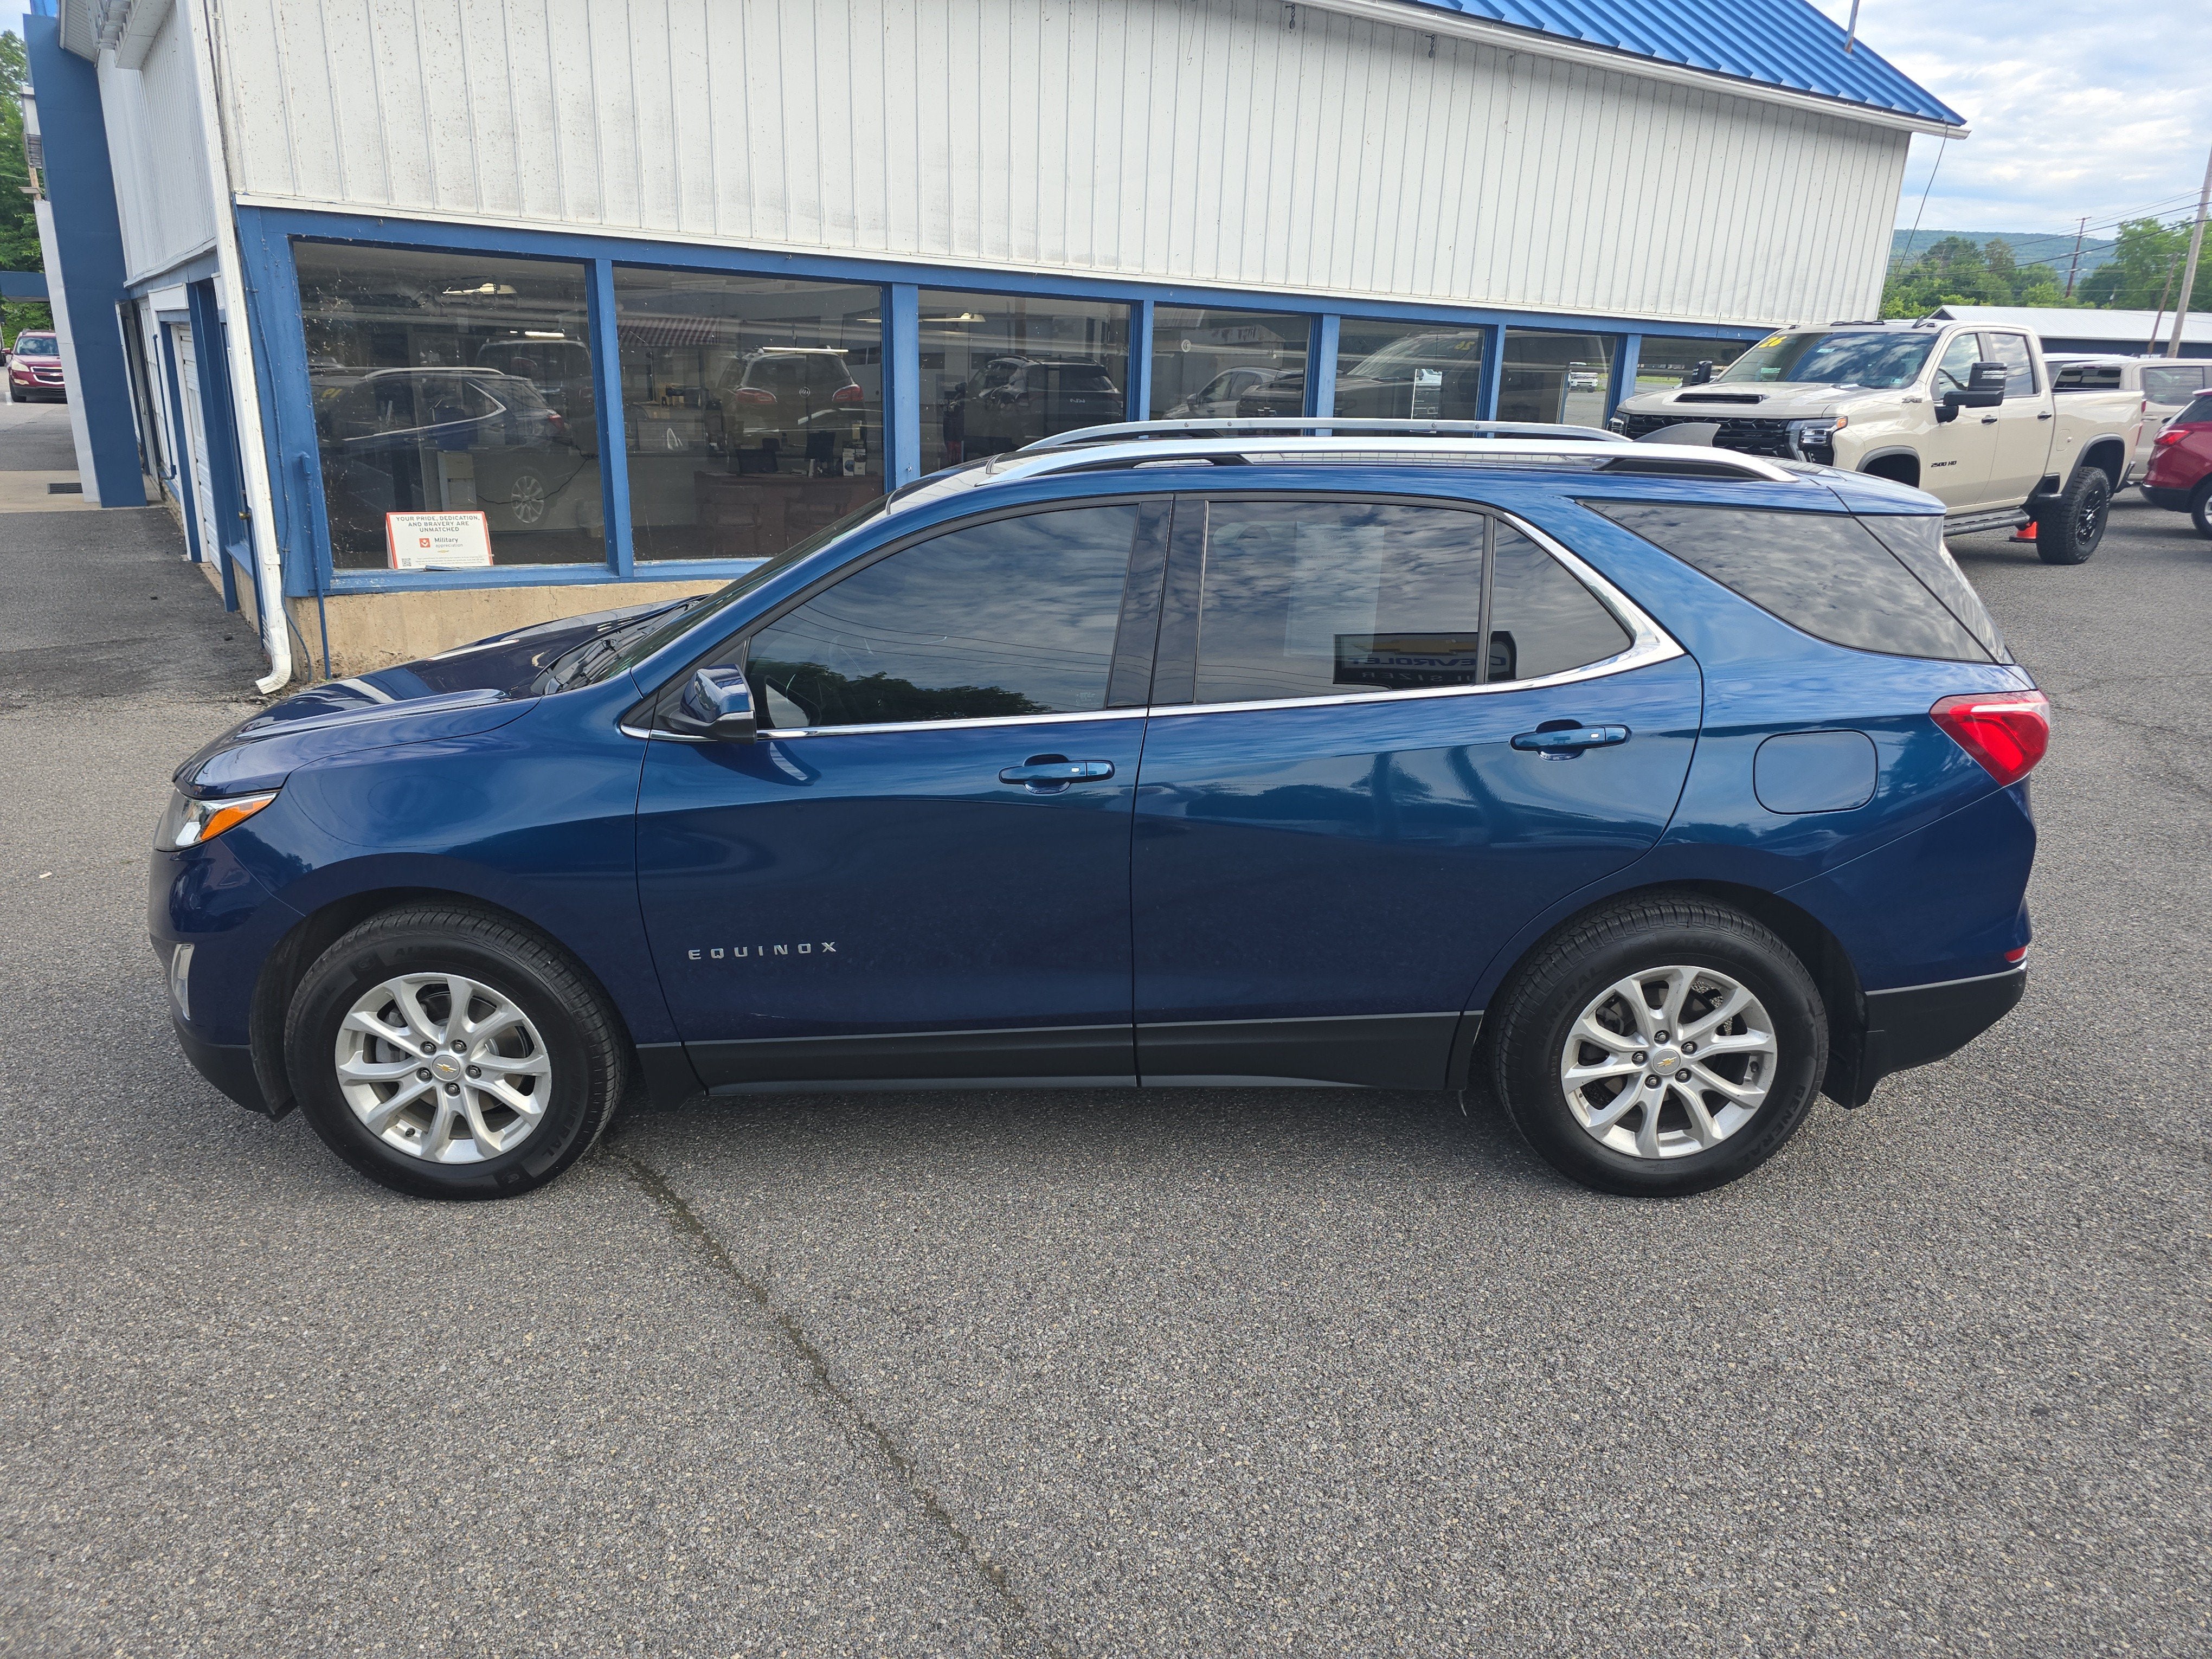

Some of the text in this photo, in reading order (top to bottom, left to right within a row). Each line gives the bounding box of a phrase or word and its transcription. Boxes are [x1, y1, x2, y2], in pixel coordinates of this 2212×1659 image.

[1758, 336, 1787, 348] 26
[688, 942, 836, 960] EQUINOX
[1734, 1084, 1806, 1163] GENERAL
